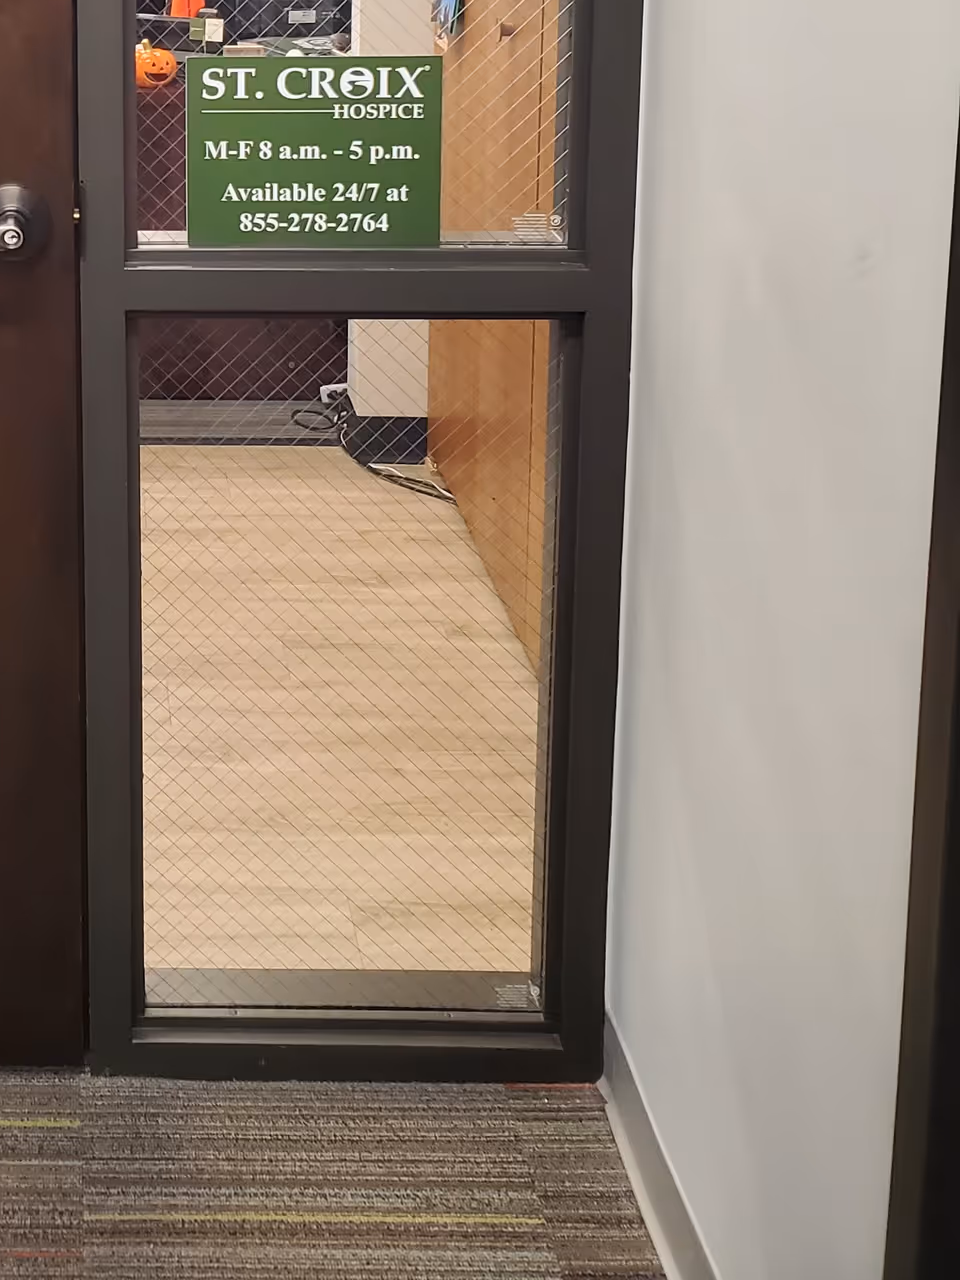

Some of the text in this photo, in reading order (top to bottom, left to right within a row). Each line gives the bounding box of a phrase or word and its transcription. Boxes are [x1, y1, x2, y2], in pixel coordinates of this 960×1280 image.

[202, 67, 424, 100] ST. CROIX
[333, 104, 424, 119] HOSPICE
[204, 141, 253, 160] M-F
[259, 141, 271, 160] 8
[279, 145, 327, 160] a.m.
[349, 141, 363, 159] 5
[369, 145, 420, 164] p.m.
[221, 183, 409, 202] Available 24/7 at
[240, 213, 388, 232] 855-278-2764
